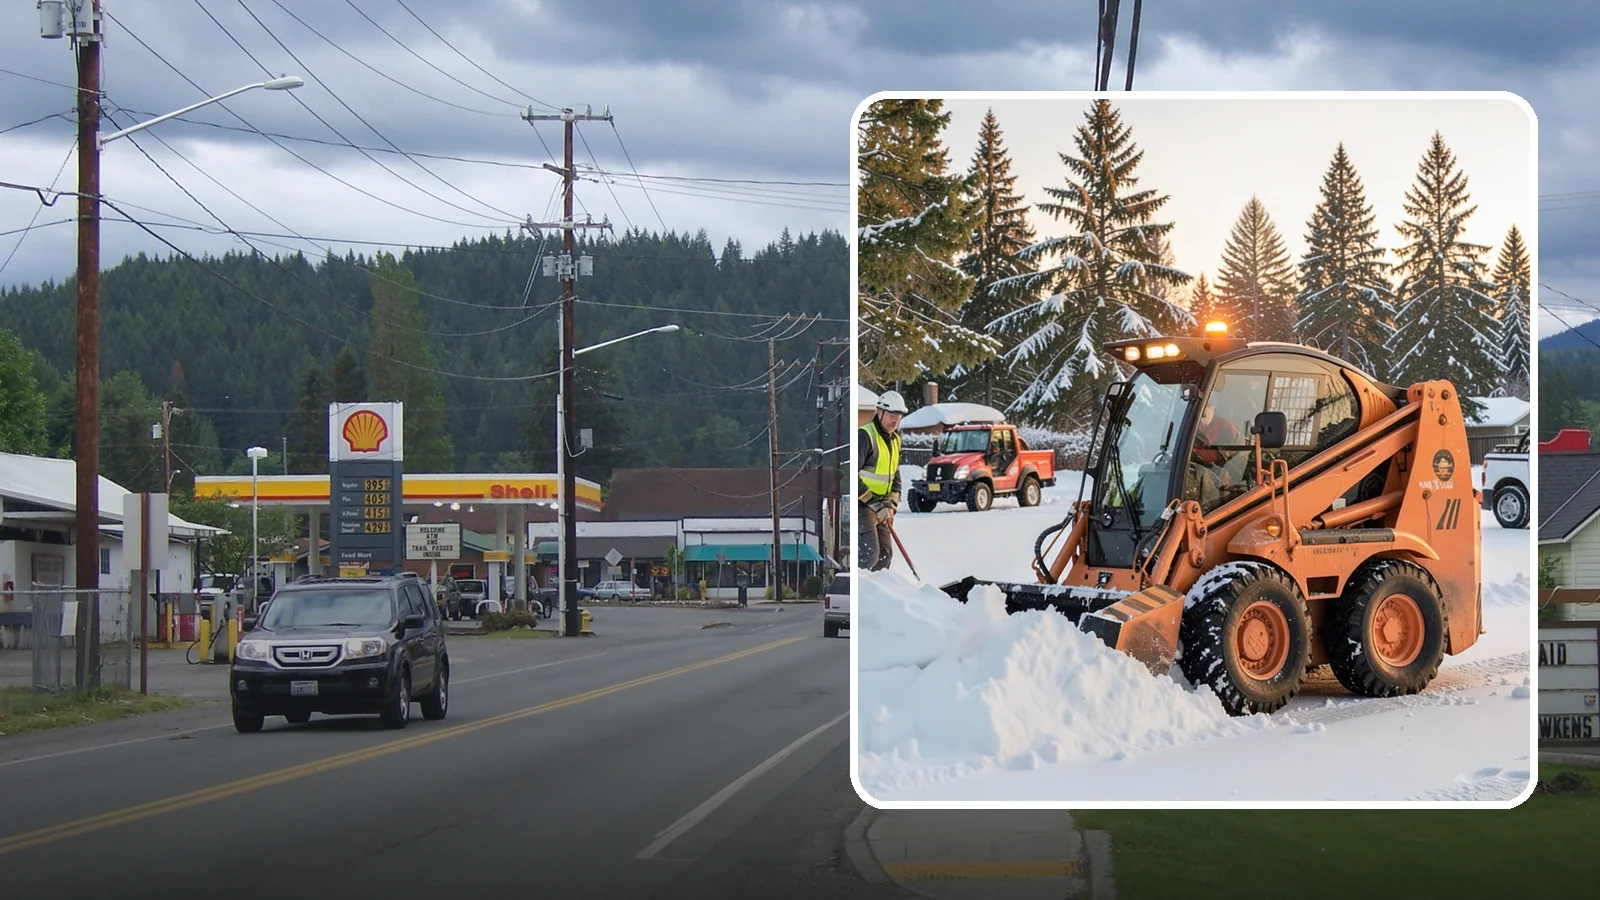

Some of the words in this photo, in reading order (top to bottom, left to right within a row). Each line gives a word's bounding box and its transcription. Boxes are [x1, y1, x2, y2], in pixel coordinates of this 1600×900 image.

[366, 480, 383, 490] 395
[490, 484, 547, 499] Shell
[366, 494, 383, 504] 405
[366, 508, 383, 518] 415
[366, 522, 383, 532] 429
